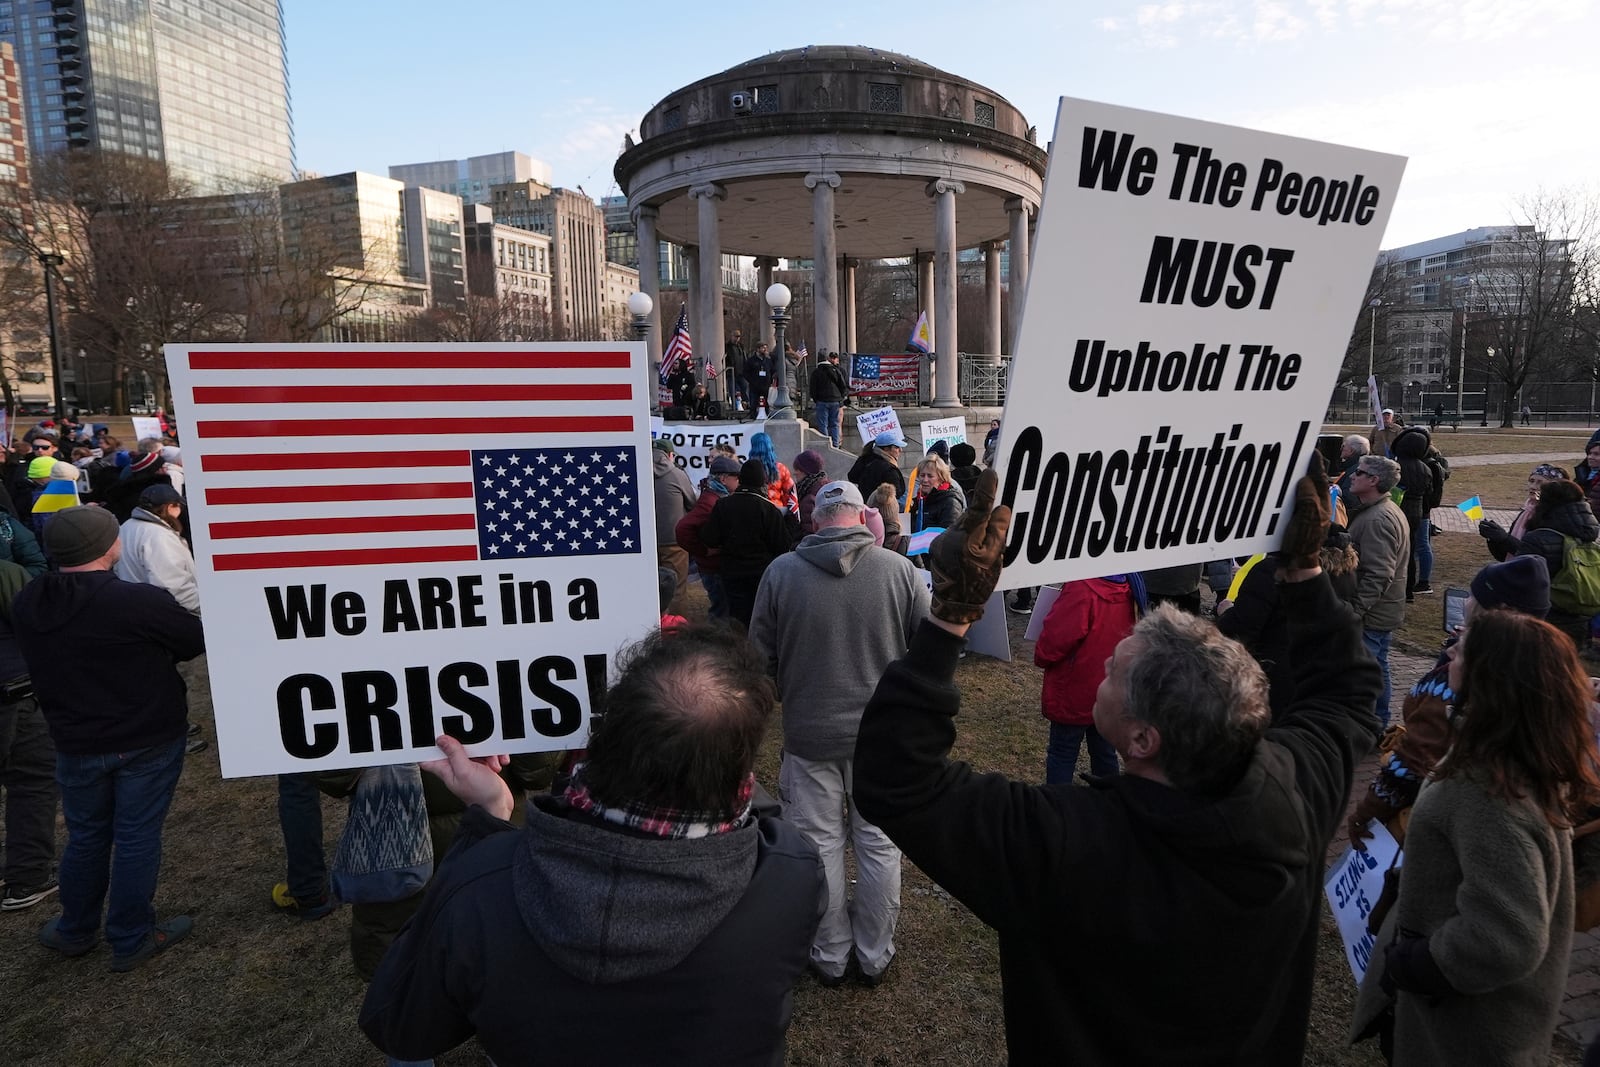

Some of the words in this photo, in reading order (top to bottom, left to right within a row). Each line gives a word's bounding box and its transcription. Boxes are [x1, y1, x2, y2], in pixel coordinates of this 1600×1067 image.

[1078, 126, 1158, 196] We
[1169, 142, 1247, 208] The
[1250, 158, 1380, 226] People
[1139, 235, 1295, 310] MUST
[1068, 339, 1231, 397] Uphold
[1234, 344, 1302, 392] The
[925, 435, 964, 448] RETING
[928, 425, 942, 435] This
[943, 425, 948, 434] is
[949, 425, 959, 434] my
[264, 584, 367, 640] We
[382, 575, 487, 633] ARE
[498, 573, 554, 625] in
[567, 577, 600, 621] a
[276, 653, 608, 760] CRISIS!
[1334, 850, 1378, 910] SILENCE
[1356, 889, 1371, 920] IS
